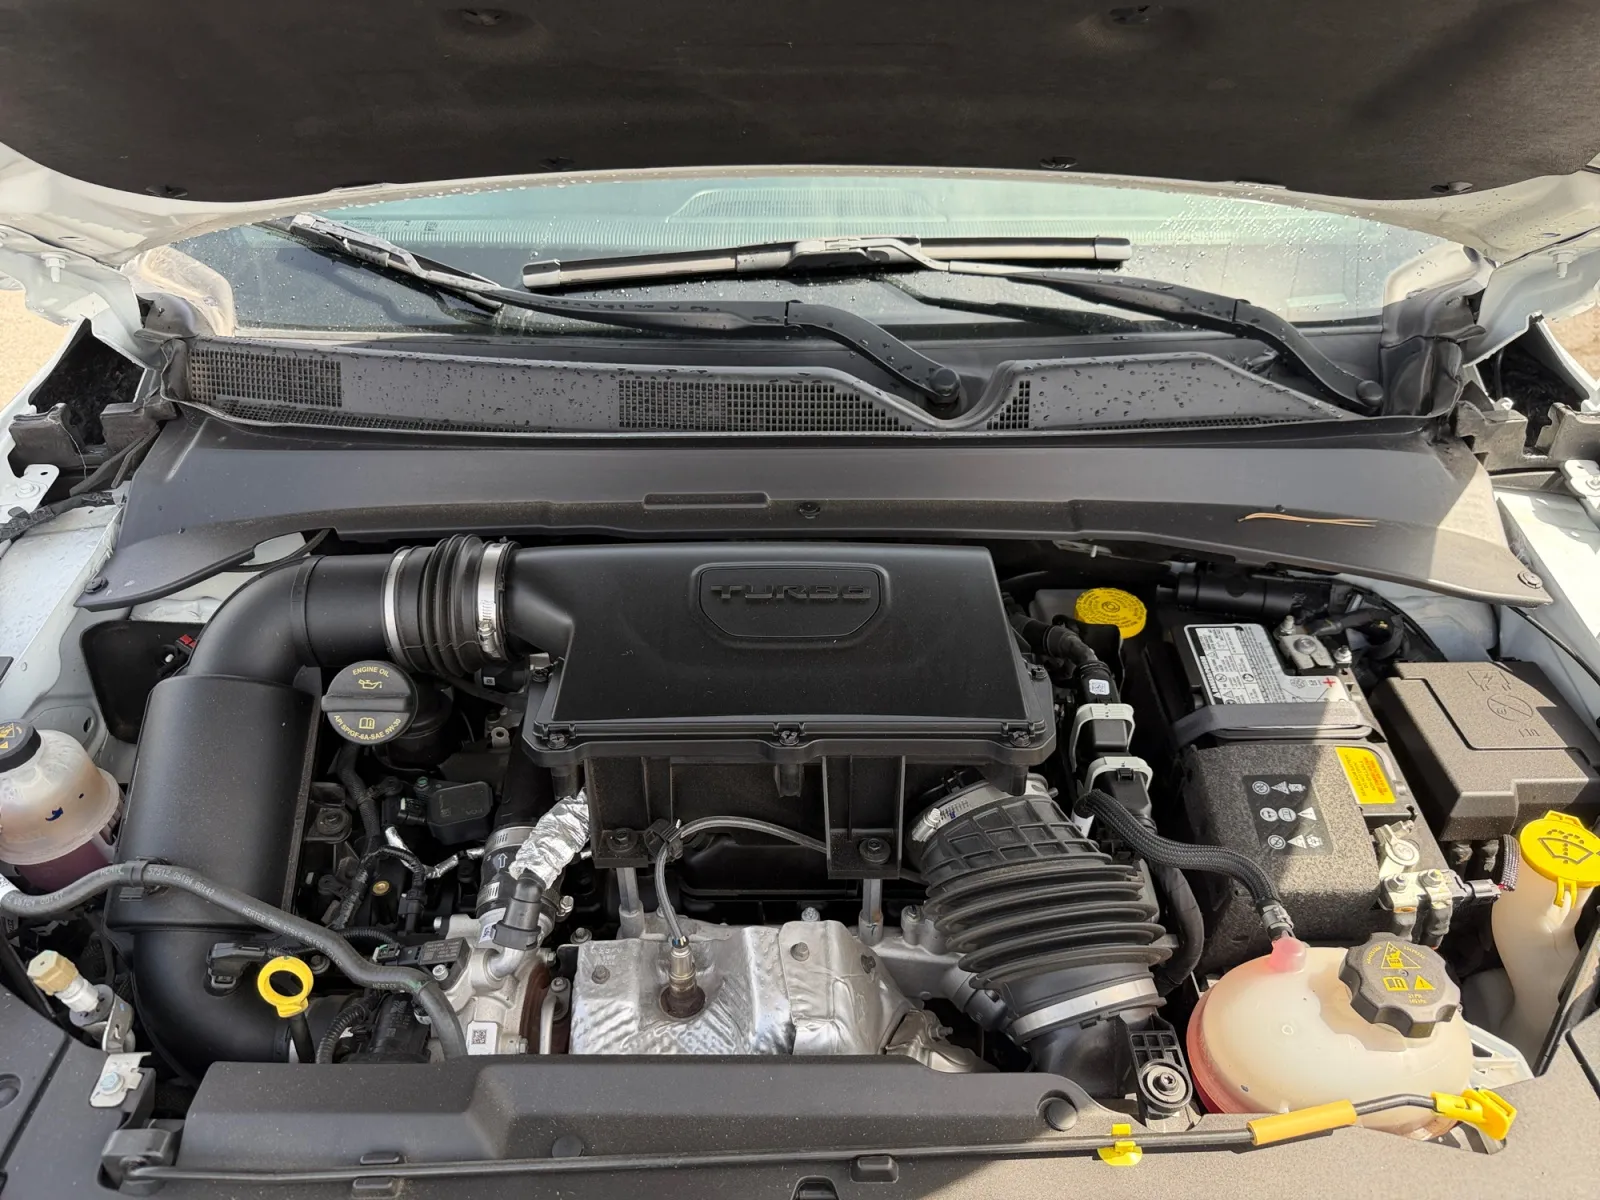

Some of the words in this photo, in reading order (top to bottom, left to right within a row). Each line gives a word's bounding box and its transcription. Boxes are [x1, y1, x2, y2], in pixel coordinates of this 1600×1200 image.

[710, 584, 872, 600] TURBO
[352, 666, 378, 676] ENGINE
[378, 667, 390, 678] OIL
[333, 715, 343, 726] API
[384, 718, 402, 735] 5W-30
[147, 867, 171, 879] 57512
